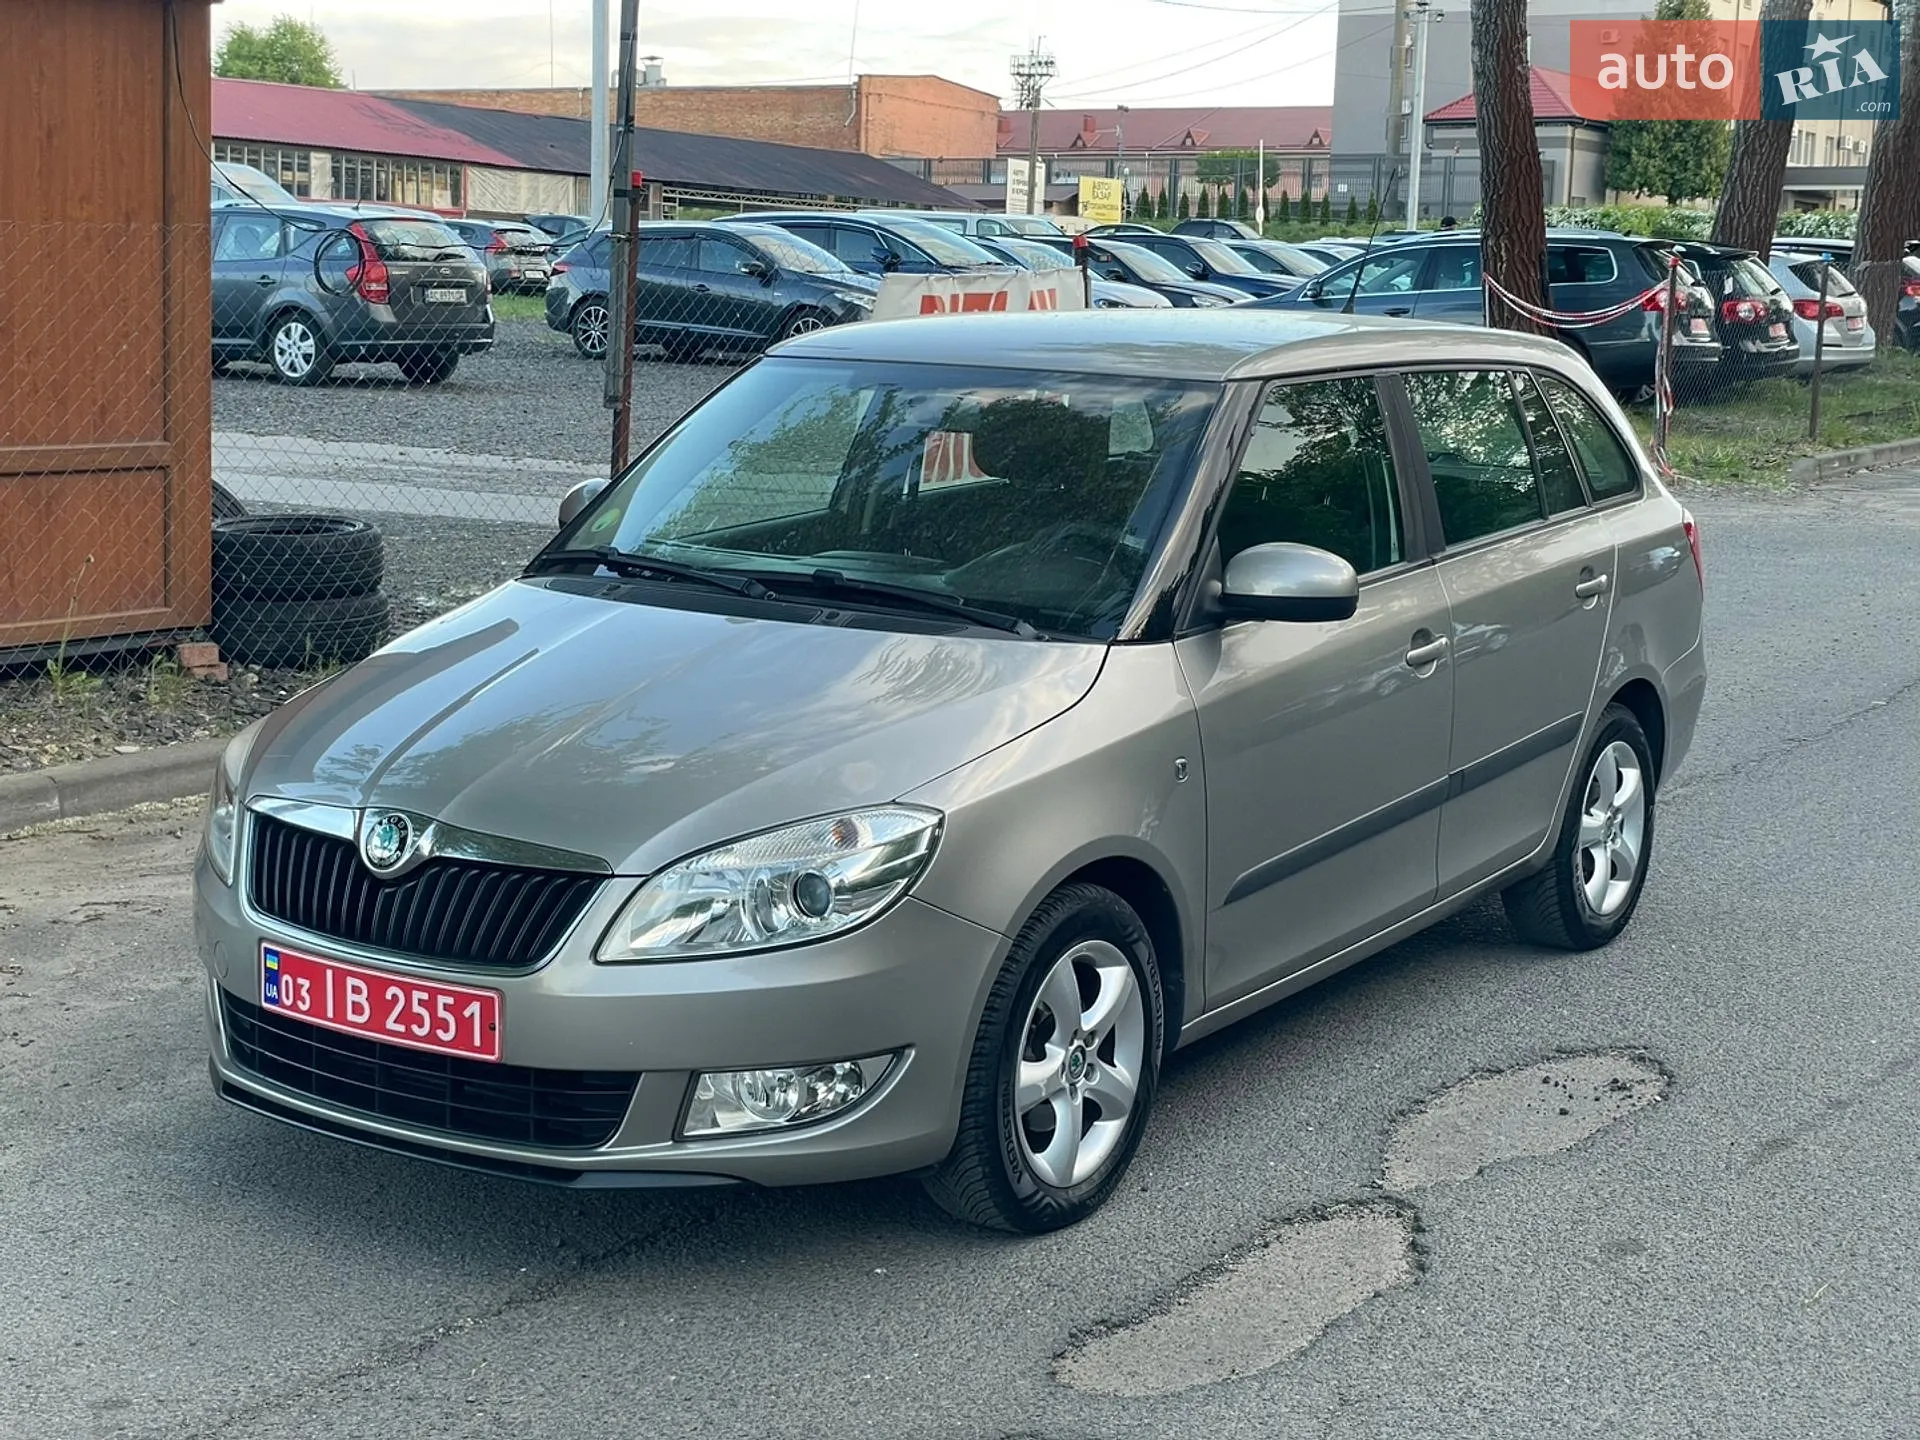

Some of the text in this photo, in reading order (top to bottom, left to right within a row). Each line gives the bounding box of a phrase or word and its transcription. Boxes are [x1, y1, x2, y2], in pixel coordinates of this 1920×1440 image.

[265, 982, 278, 1000] UA
[281, 974, 311, 1012] 03
[385, 986, 481, 1047] 2551
